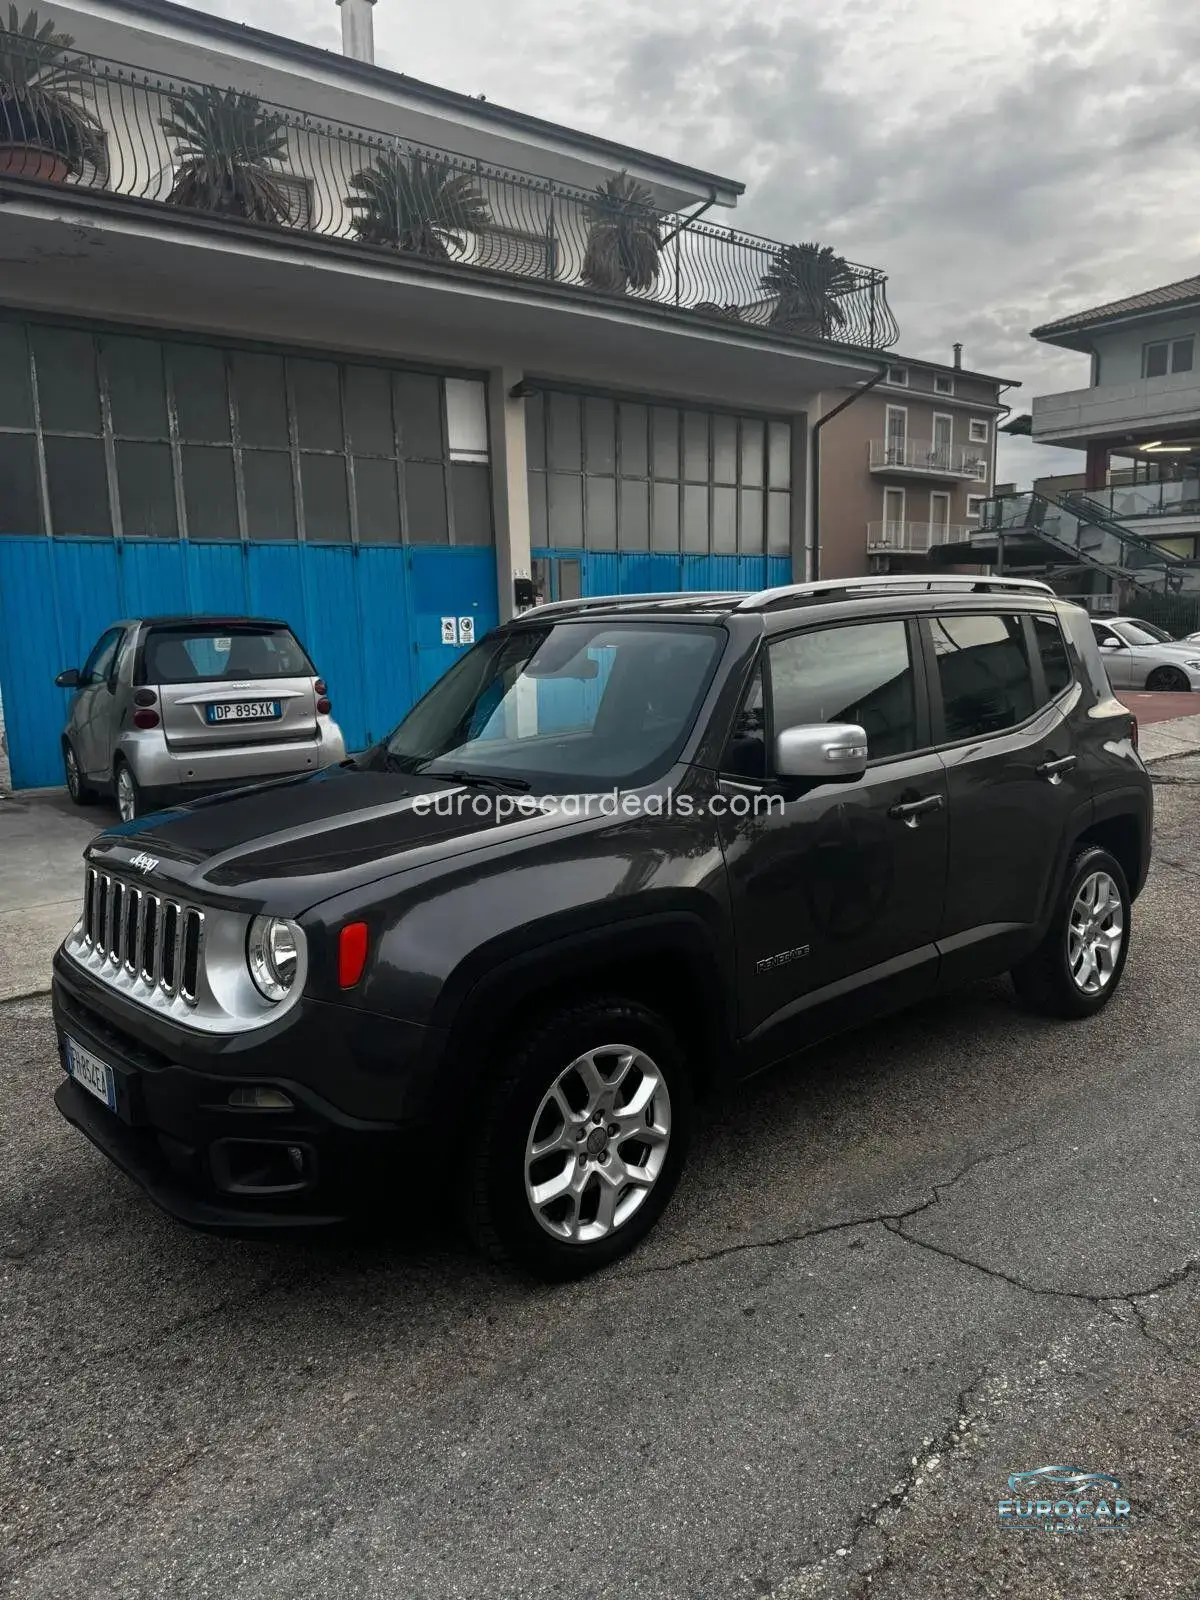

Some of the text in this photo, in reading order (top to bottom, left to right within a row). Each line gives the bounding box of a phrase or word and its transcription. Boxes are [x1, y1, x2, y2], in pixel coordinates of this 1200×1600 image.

[216, 702, 273, 719] DP 895XK
[130, 851, 159, 875] Jeep
[756, 944, 810, 974] RENEGADE
